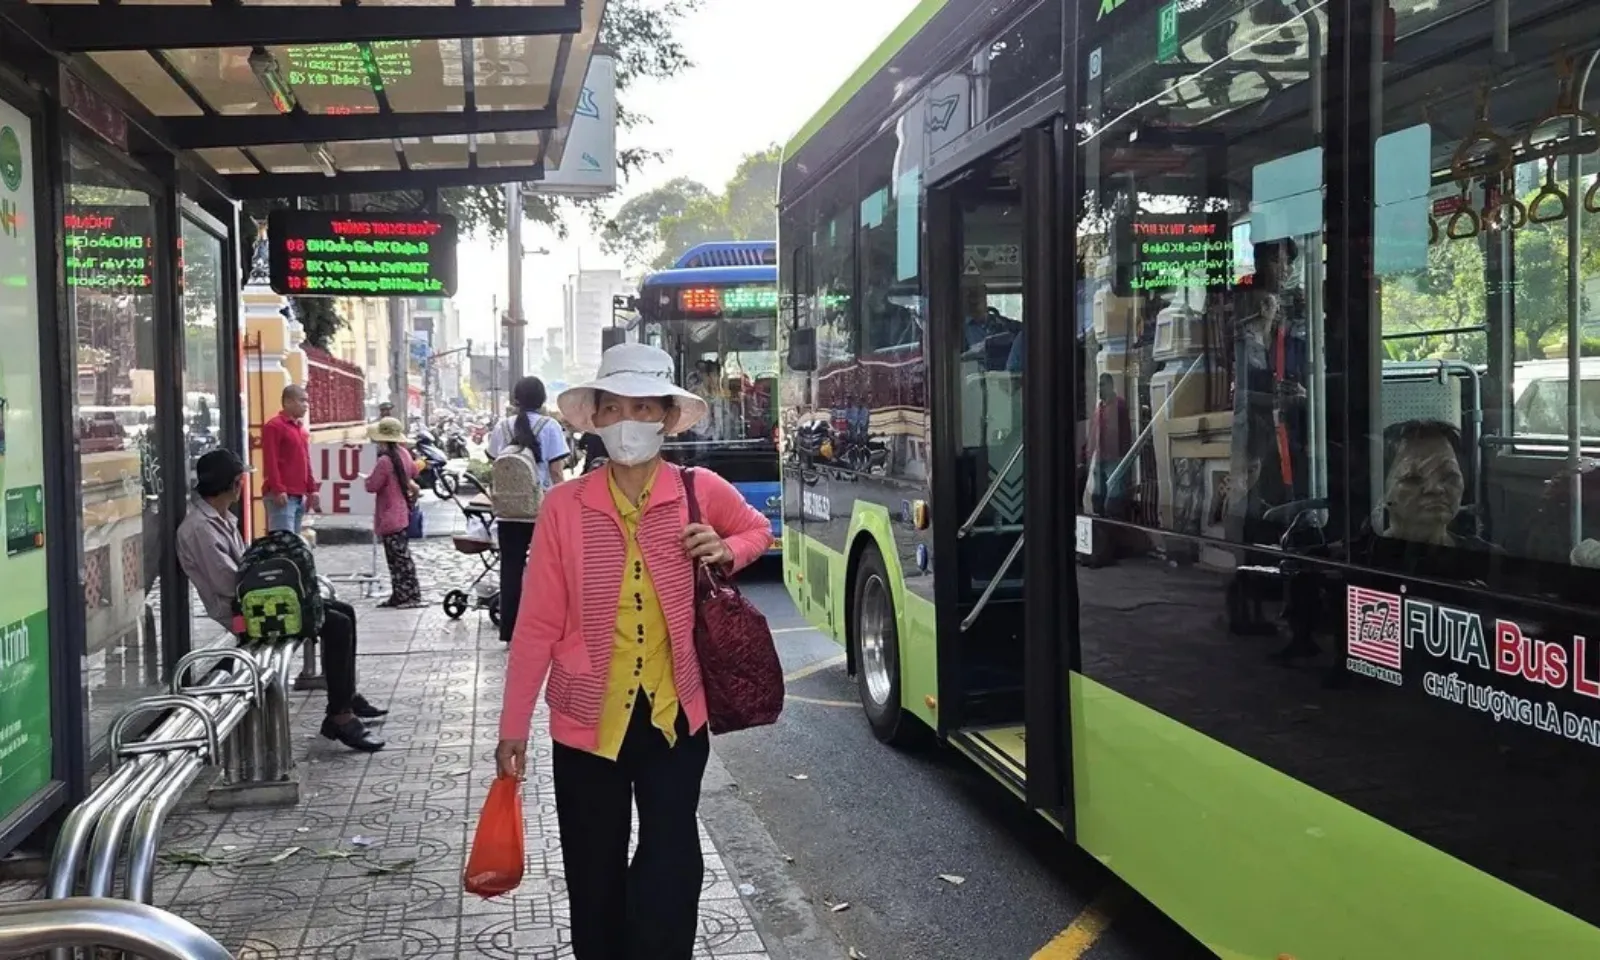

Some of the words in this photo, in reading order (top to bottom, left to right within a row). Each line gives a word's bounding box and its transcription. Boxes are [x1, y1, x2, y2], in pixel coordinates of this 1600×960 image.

[322, 443, 362, 480] IỮ
[1404, 598, 1490, 670] FUTA
[1423, 672, 1467, 704] CHẤT
[1468, 683, 1532, 726] LƯỢNG
[1534, 702, 1562, 735] LÀ
